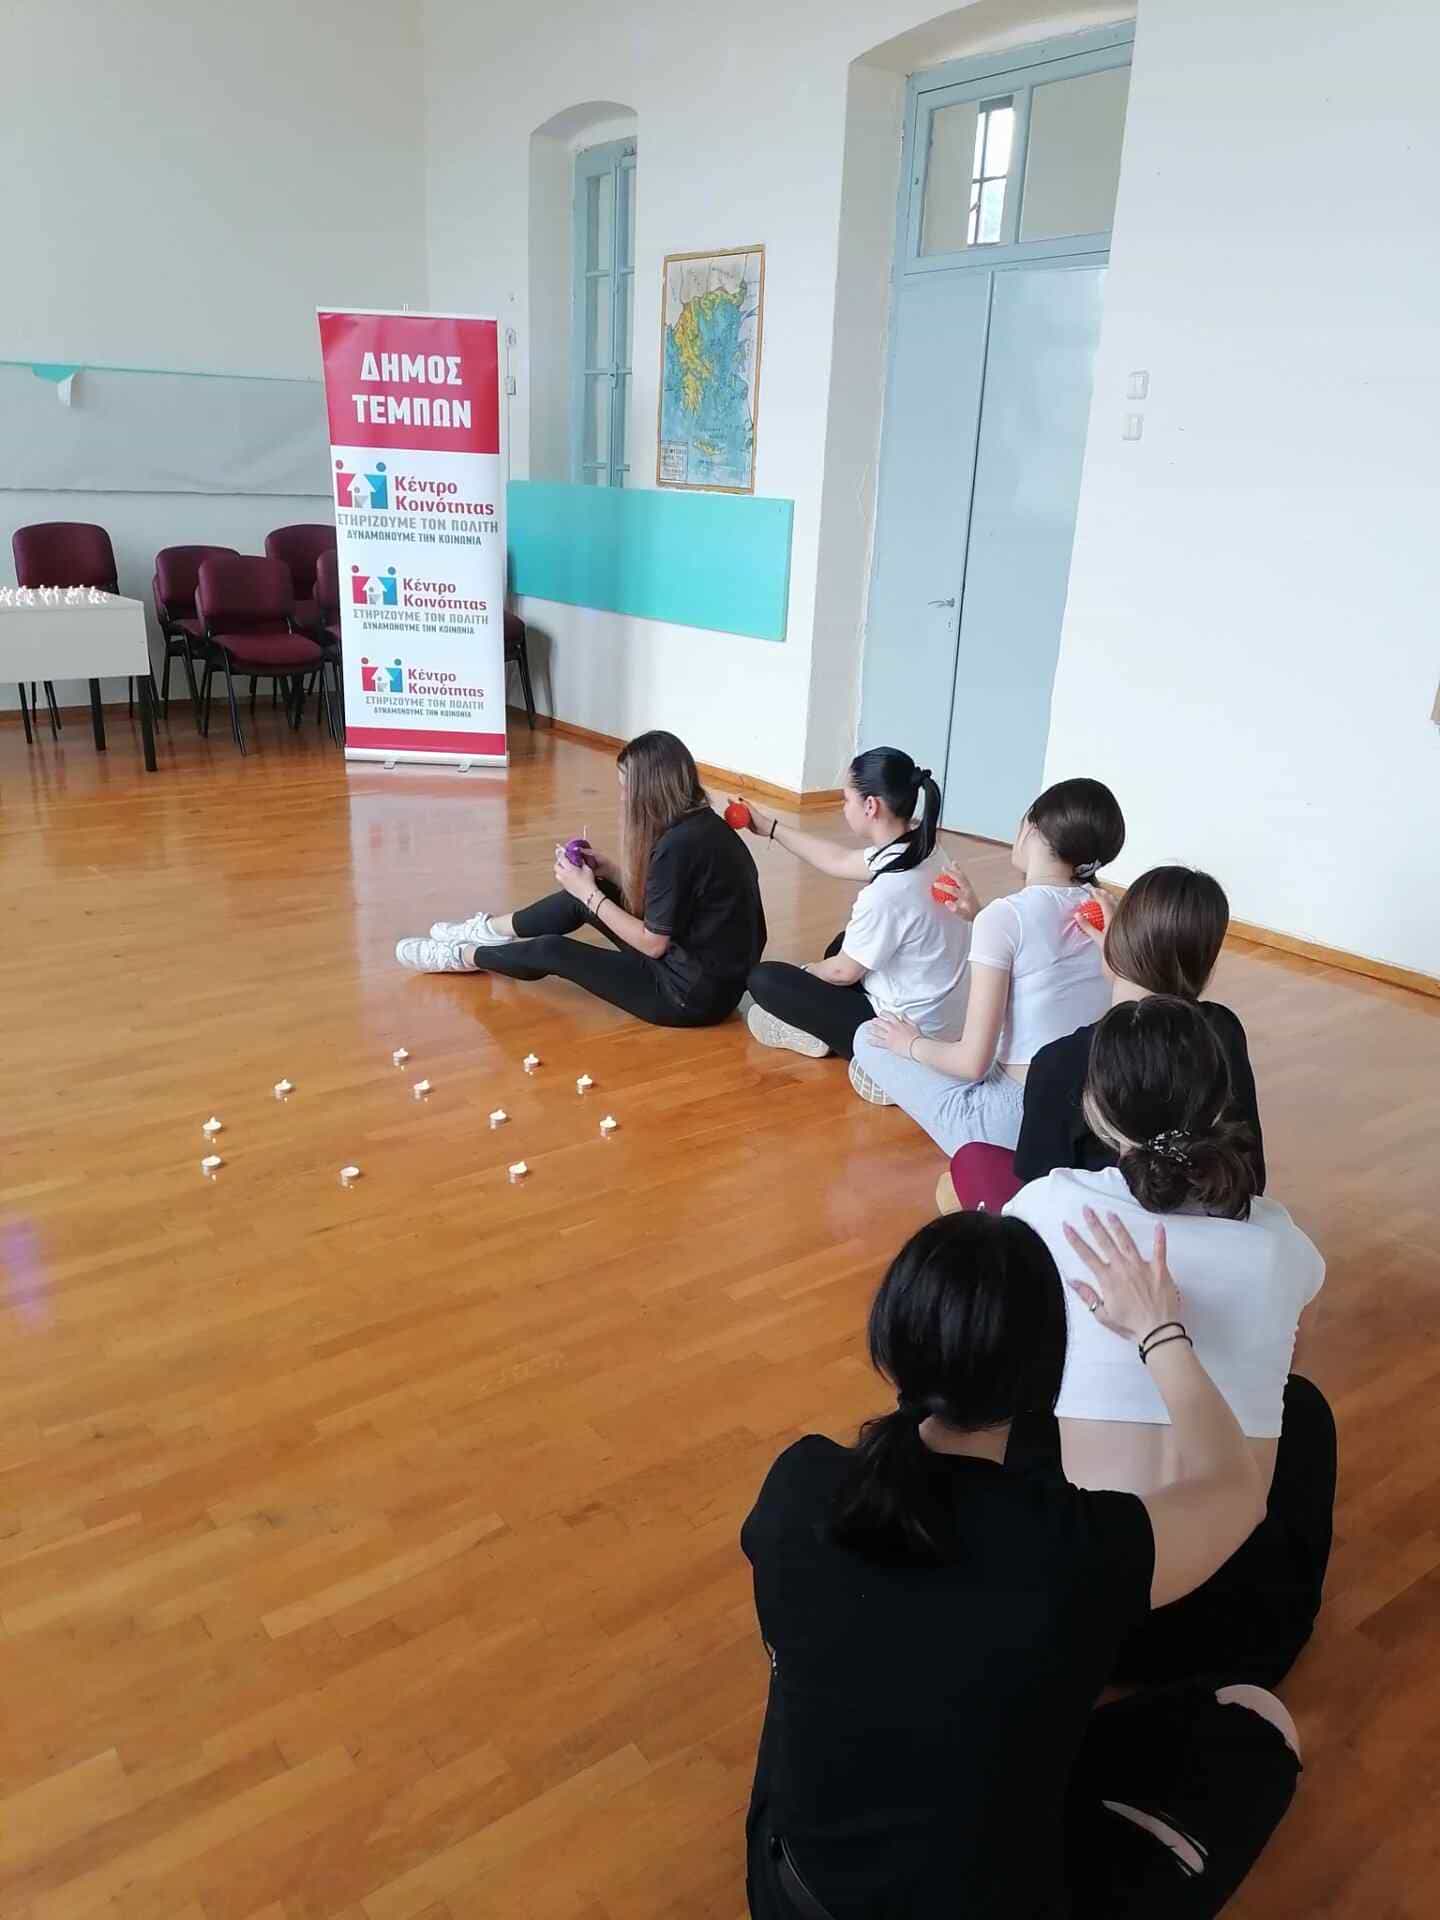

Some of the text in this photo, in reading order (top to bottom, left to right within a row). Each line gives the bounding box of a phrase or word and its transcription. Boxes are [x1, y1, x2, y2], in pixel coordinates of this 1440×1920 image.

[360, 351, 462, 385] ΔΗΜΟΣ
[352, 394, 471, 429] ΤΕΜΠΩΝ
[394, 475, 458, 496] Κέντρο
[396, 495, 494, 516] Κοινότητας
[337, 513, 498, 534] ΣΤΗΡΙΖΟΥΜΕ ΤΟΝ ΠΟΛΙΤΗ
[403, 578, 456, 595] Κέντρο
[403, 594, 487, 611] Κοινότητας
[353, 608, 489, 625] ΣΤΗΡΙΖΟΥΜΕ ΤΟΝ ΠΟΛΙΤΗ
[408, 668, 456, 684] Κέντρο
[408, 682, 484, 698] Κοινότητας
[365, 695, 485, 710] ΣΤΗΡΙΖΟΥΜΕ ΤΟΝ ΠΟΛΙΤΗ
